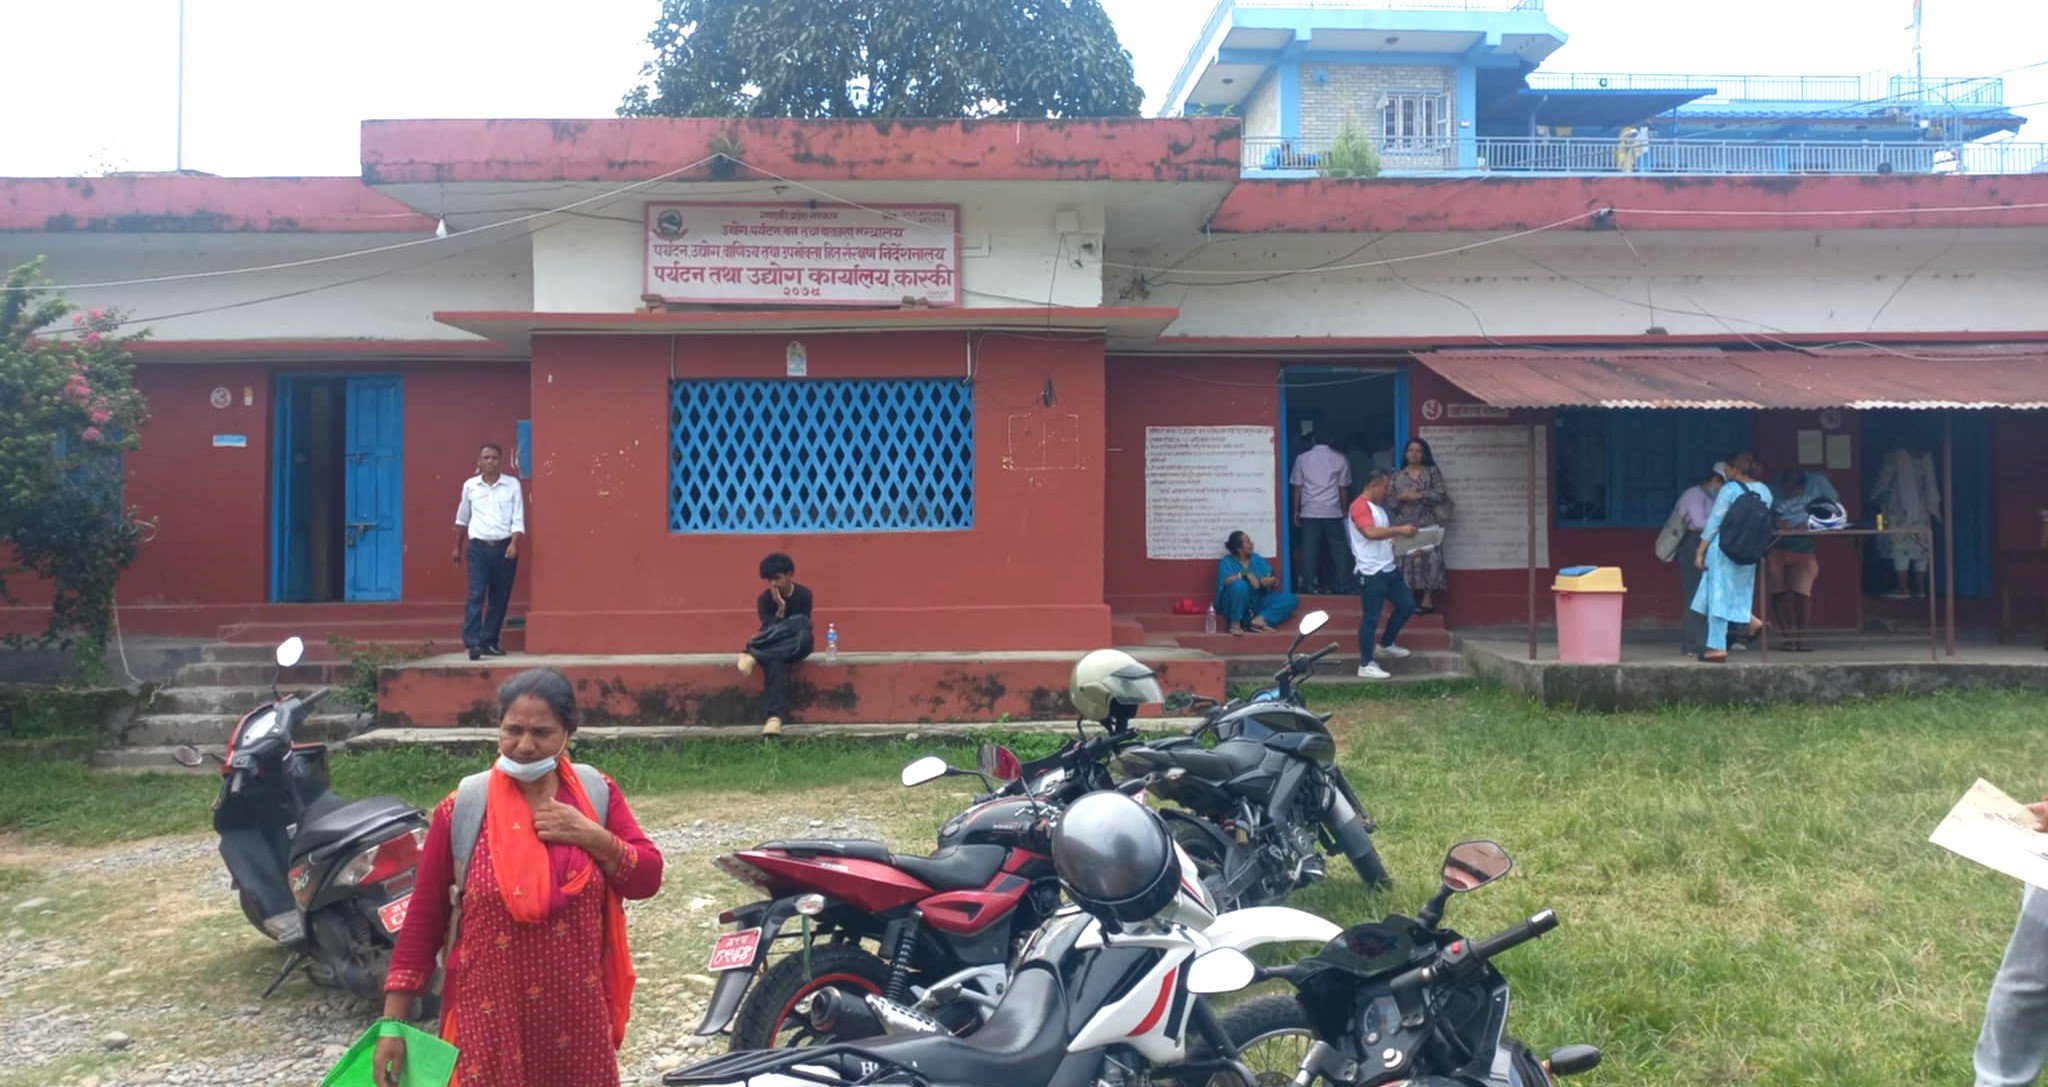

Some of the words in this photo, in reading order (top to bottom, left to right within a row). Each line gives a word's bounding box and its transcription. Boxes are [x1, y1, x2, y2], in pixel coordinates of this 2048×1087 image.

[653, 260, 706, 284] पर्यटन
[709, 266, 744, 285] तथा
[747, 261, 804, 286] उद्योग
[893, 264, 954, 288] कास्की
